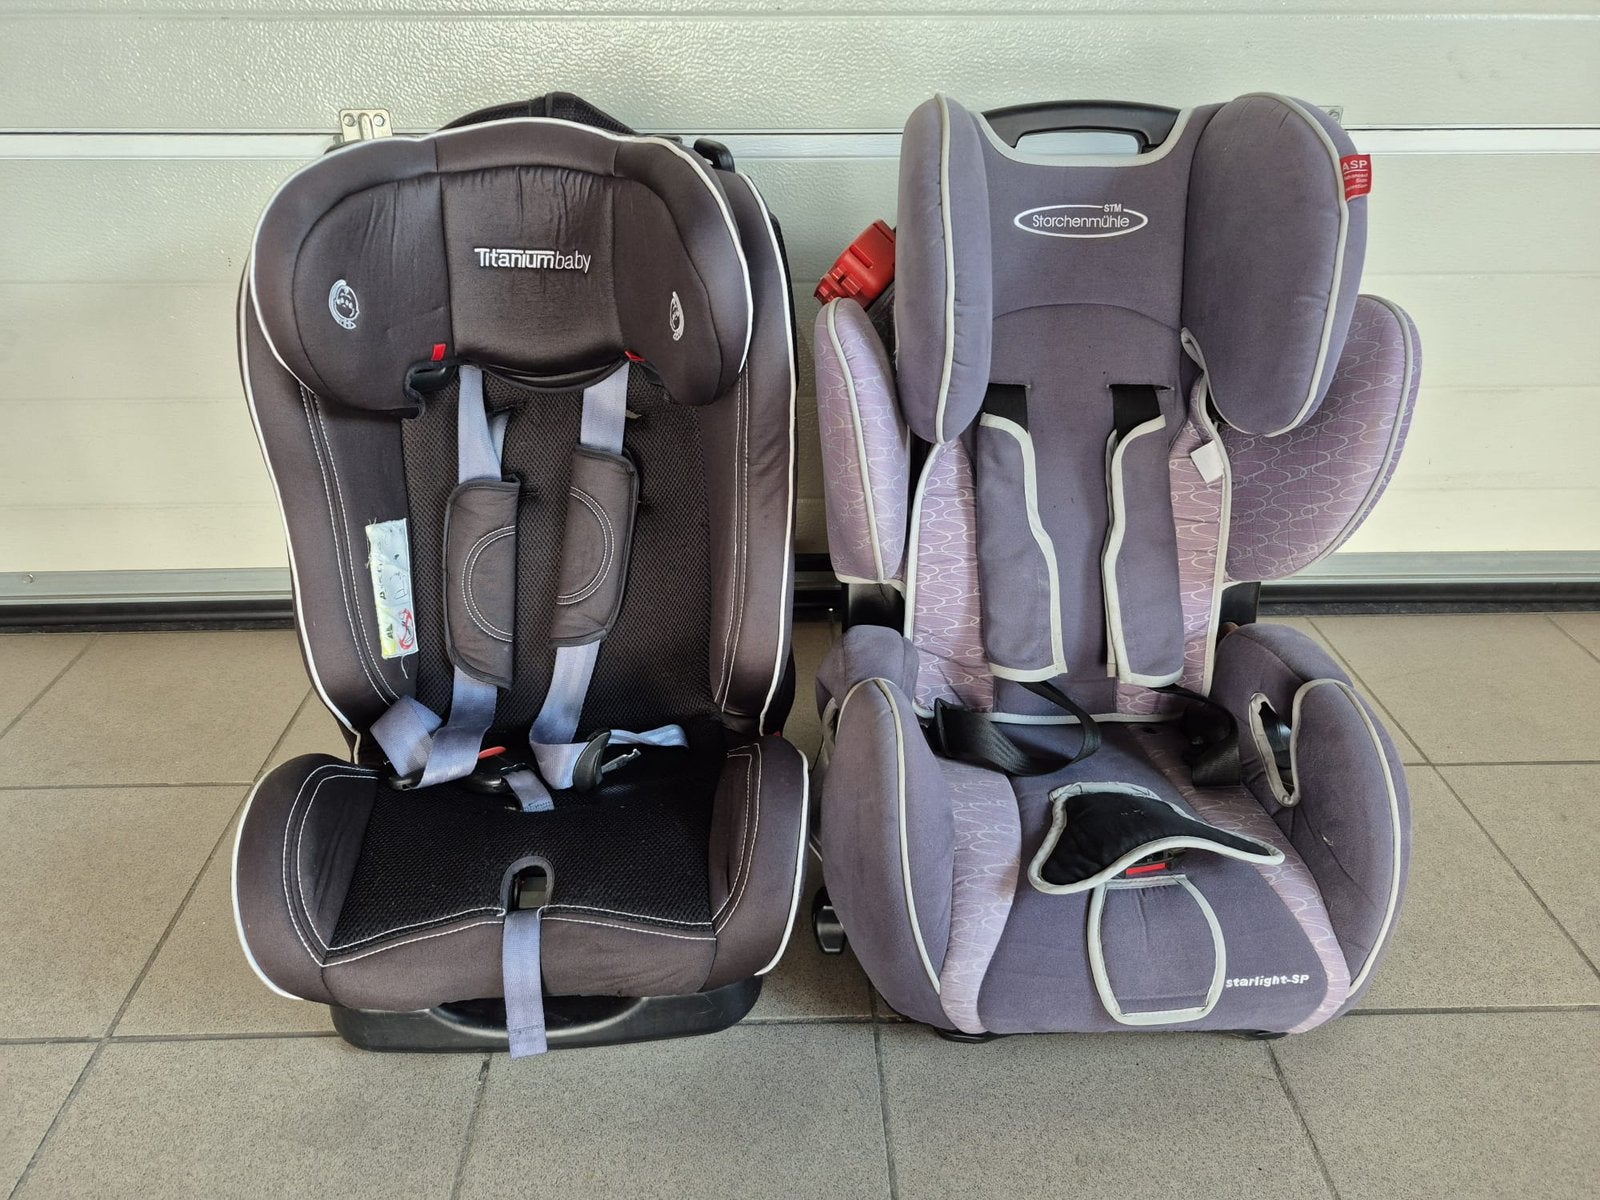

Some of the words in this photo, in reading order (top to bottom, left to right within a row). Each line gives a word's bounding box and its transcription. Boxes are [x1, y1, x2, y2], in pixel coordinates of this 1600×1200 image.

[1342, 160, 1368, 171] ASP
[1103, 204, 1122, 213] STM
[1032, 214, 1130, 228] Storchenmühle
[474, 248, 592, 274] Titaniumbaby
[1225, 974, 1310, 988] starlight-SP
